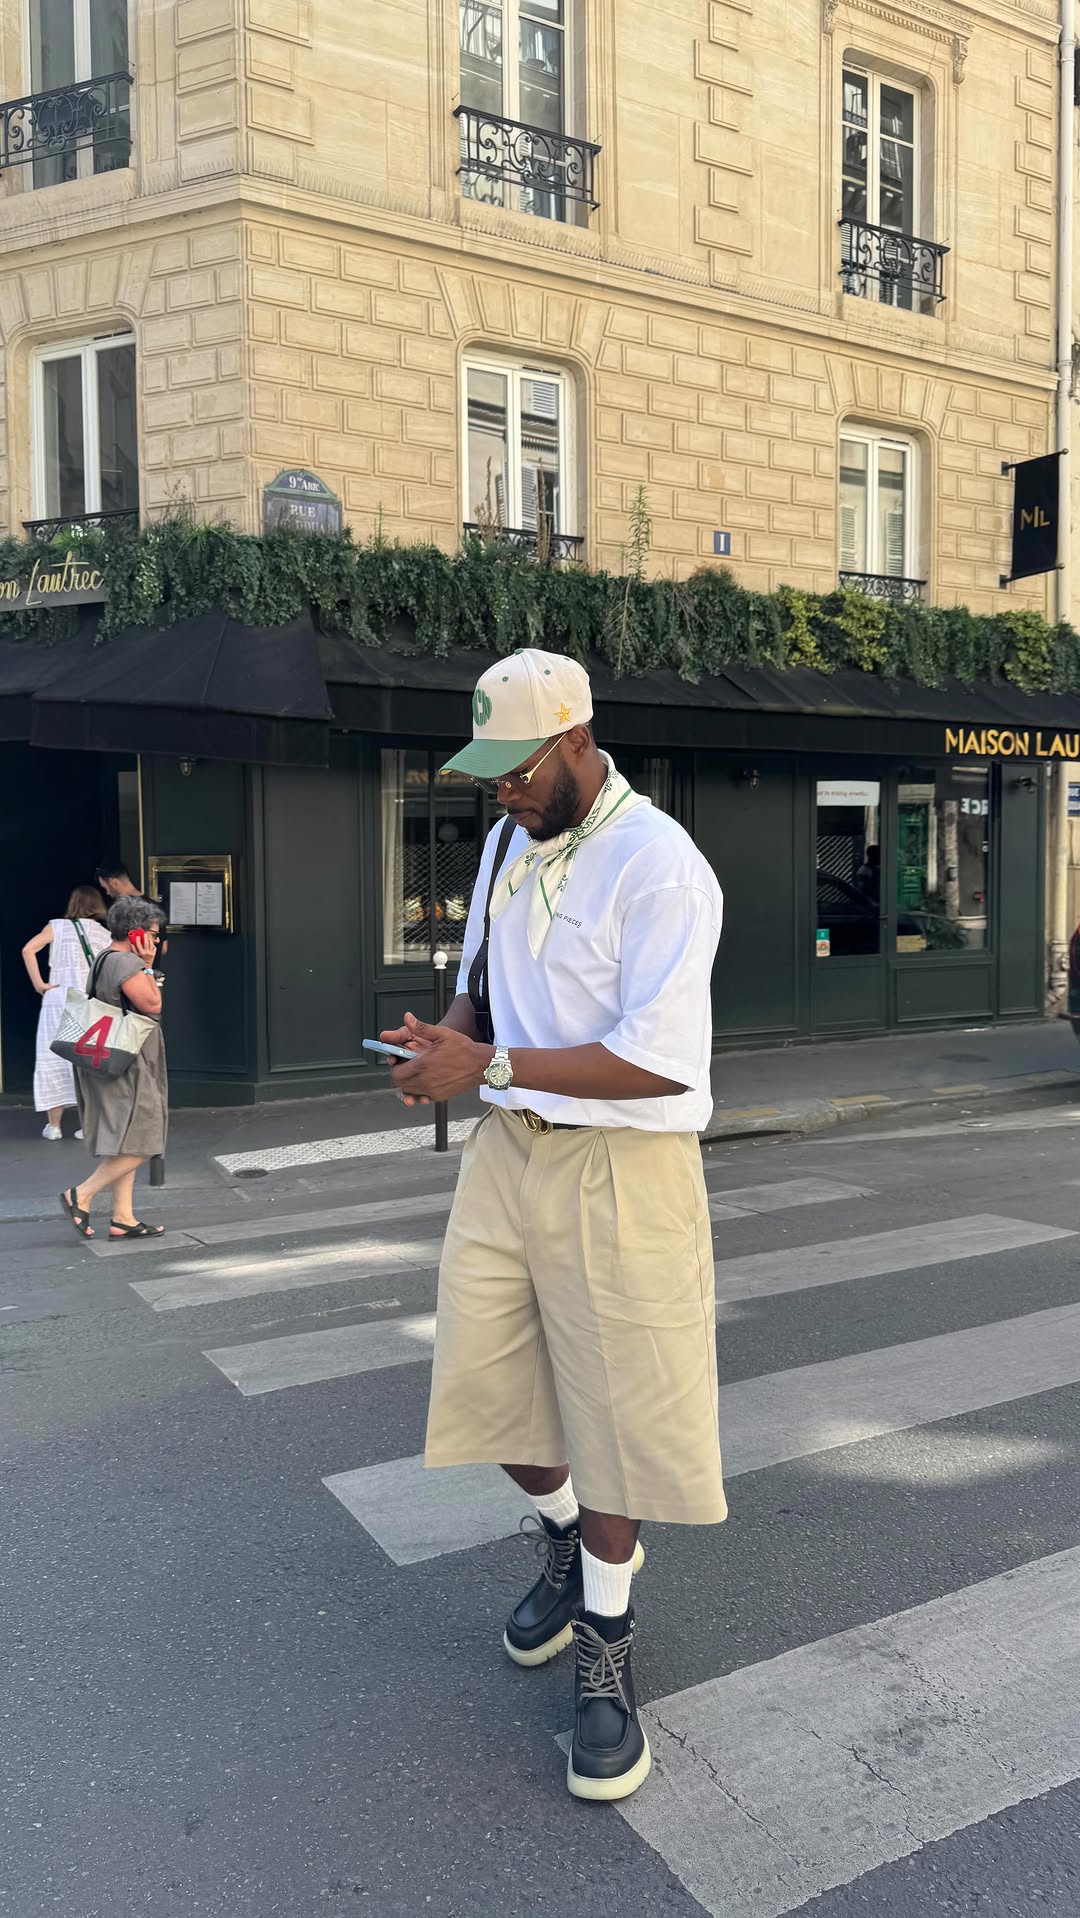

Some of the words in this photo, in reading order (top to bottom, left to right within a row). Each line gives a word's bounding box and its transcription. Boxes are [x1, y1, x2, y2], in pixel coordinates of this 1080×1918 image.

[290, 504, 316, 518] RUE
[1020, 505, 1050, 530] ML
[26, 550, 105, 606] Lautrec
[945, 728, 1029, 756] MAISON
[1035, 731, 1080, 758] LAU
[563, 915, 582, 929] PIECES
[73, 1015, 113, 1069] 4
